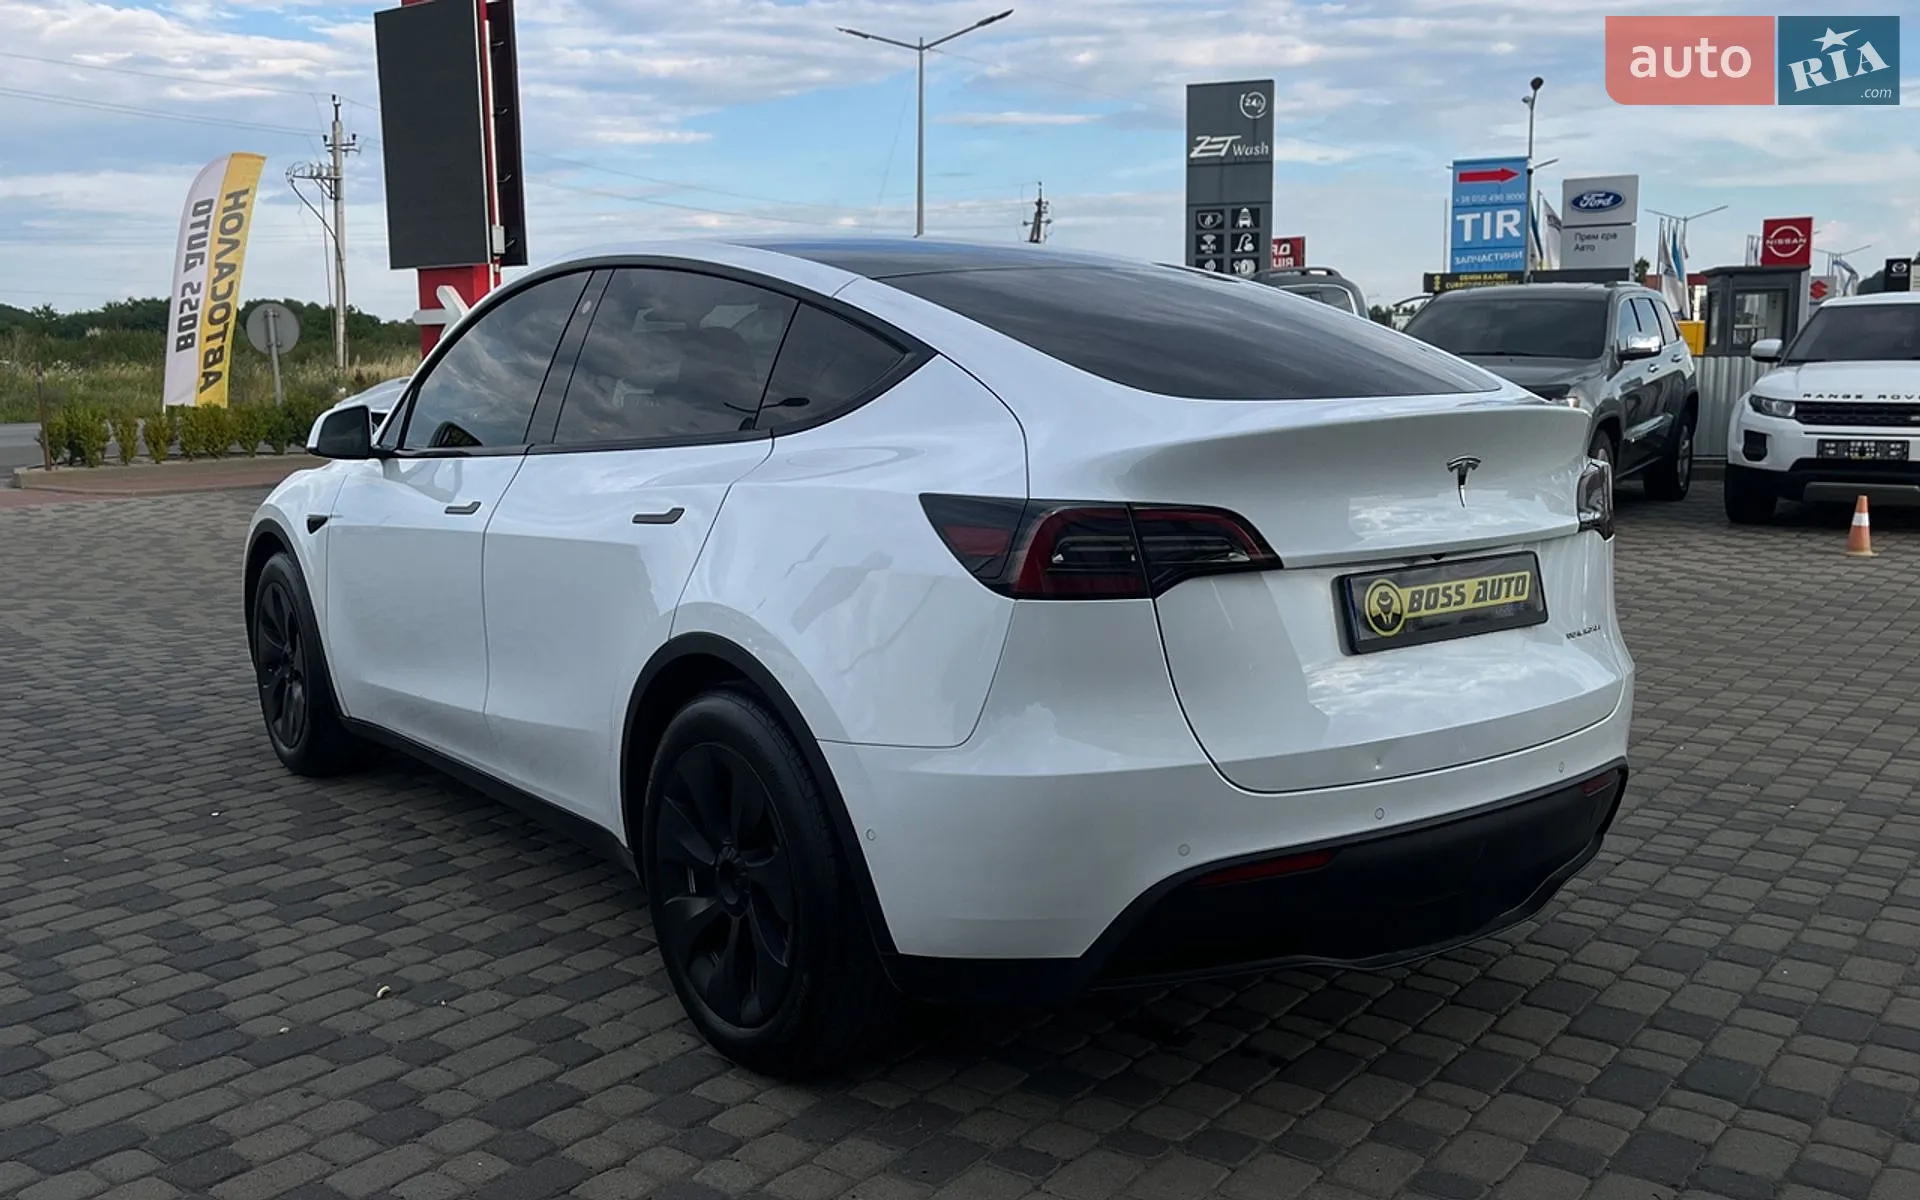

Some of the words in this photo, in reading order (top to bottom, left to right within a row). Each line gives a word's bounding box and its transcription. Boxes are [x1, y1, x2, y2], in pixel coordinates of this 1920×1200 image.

[1189, 135, 1242, 158] ZET
[1232, 141, 1269, 157] Wash
[1579, 192, 1615, 208] Ford
[1456, 209, 1521, 241] TIR
[1765, 237, 1807, 246] NISSAN
[1407, 583, 1466, 613] BOSS
[1472, 574, 1528, 603] AUTO
